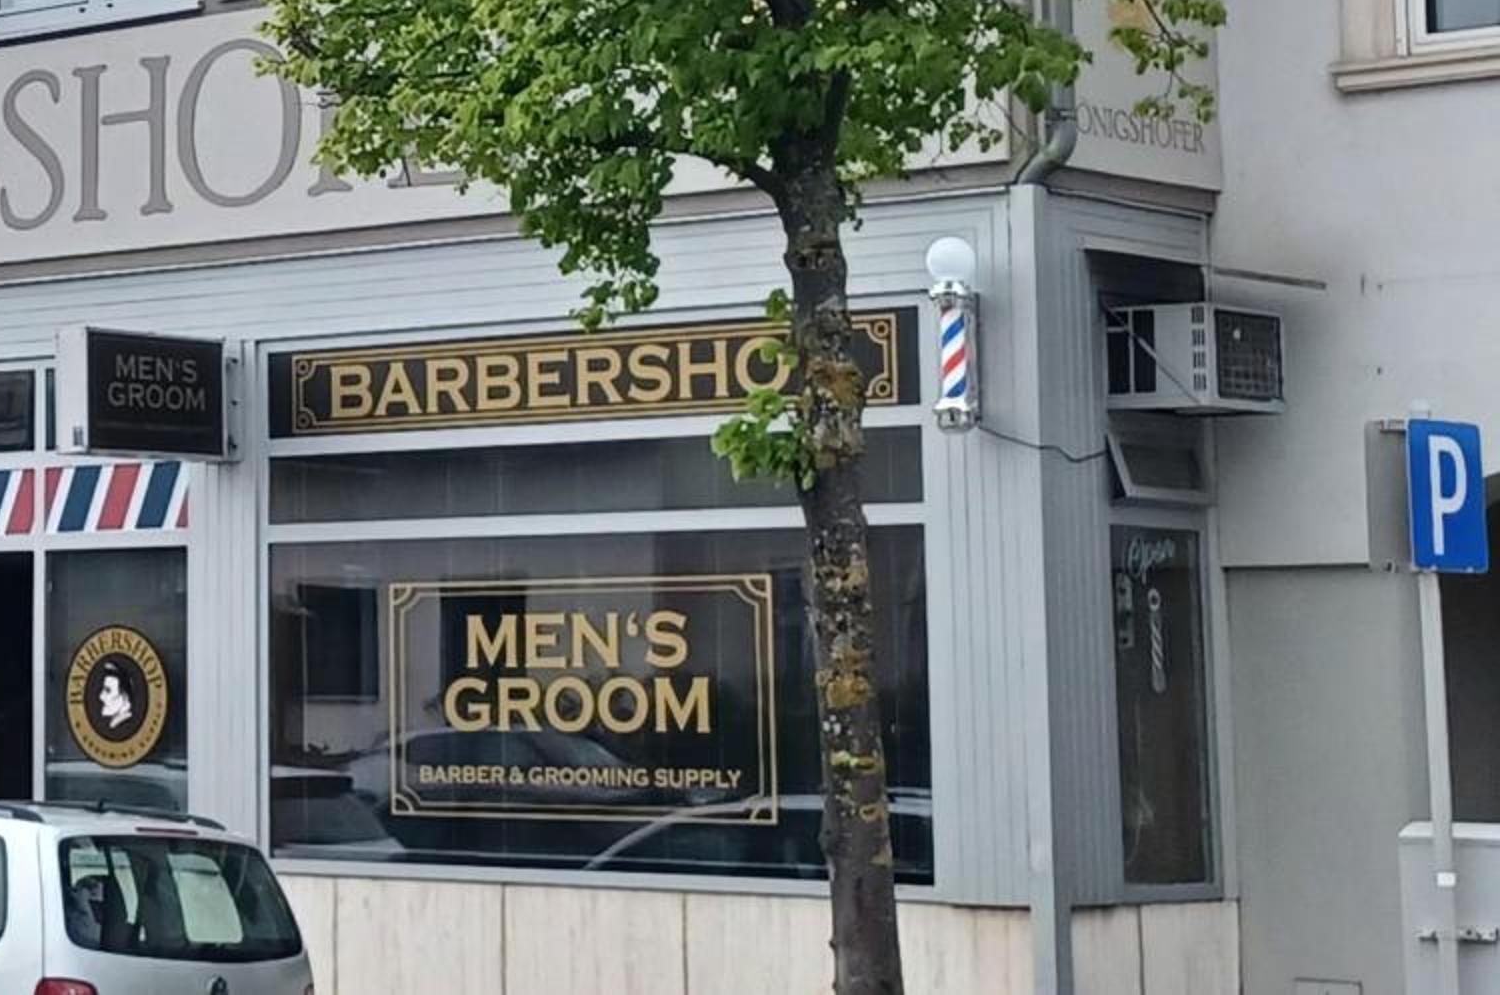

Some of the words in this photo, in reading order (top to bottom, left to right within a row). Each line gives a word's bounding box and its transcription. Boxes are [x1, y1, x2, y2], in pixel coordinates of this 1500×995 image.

[1076, 95, 1206, 154] ÖNIGSHOFER
[107, 381, 205, 412] GROOM
[330, 336, 790, 419] BARBERSHO
[1428, 434, 1467, 556] P
[69, 629, 163, 704] BARBERSHOP
[444, 676, 711, 734] GROOM
[419, 765, 505, 784] BARBER
[508, 766, 525, 784] &
[528, 766, 650, 787] GROOMING
[654, 768, 742, 789] SUPPLY
